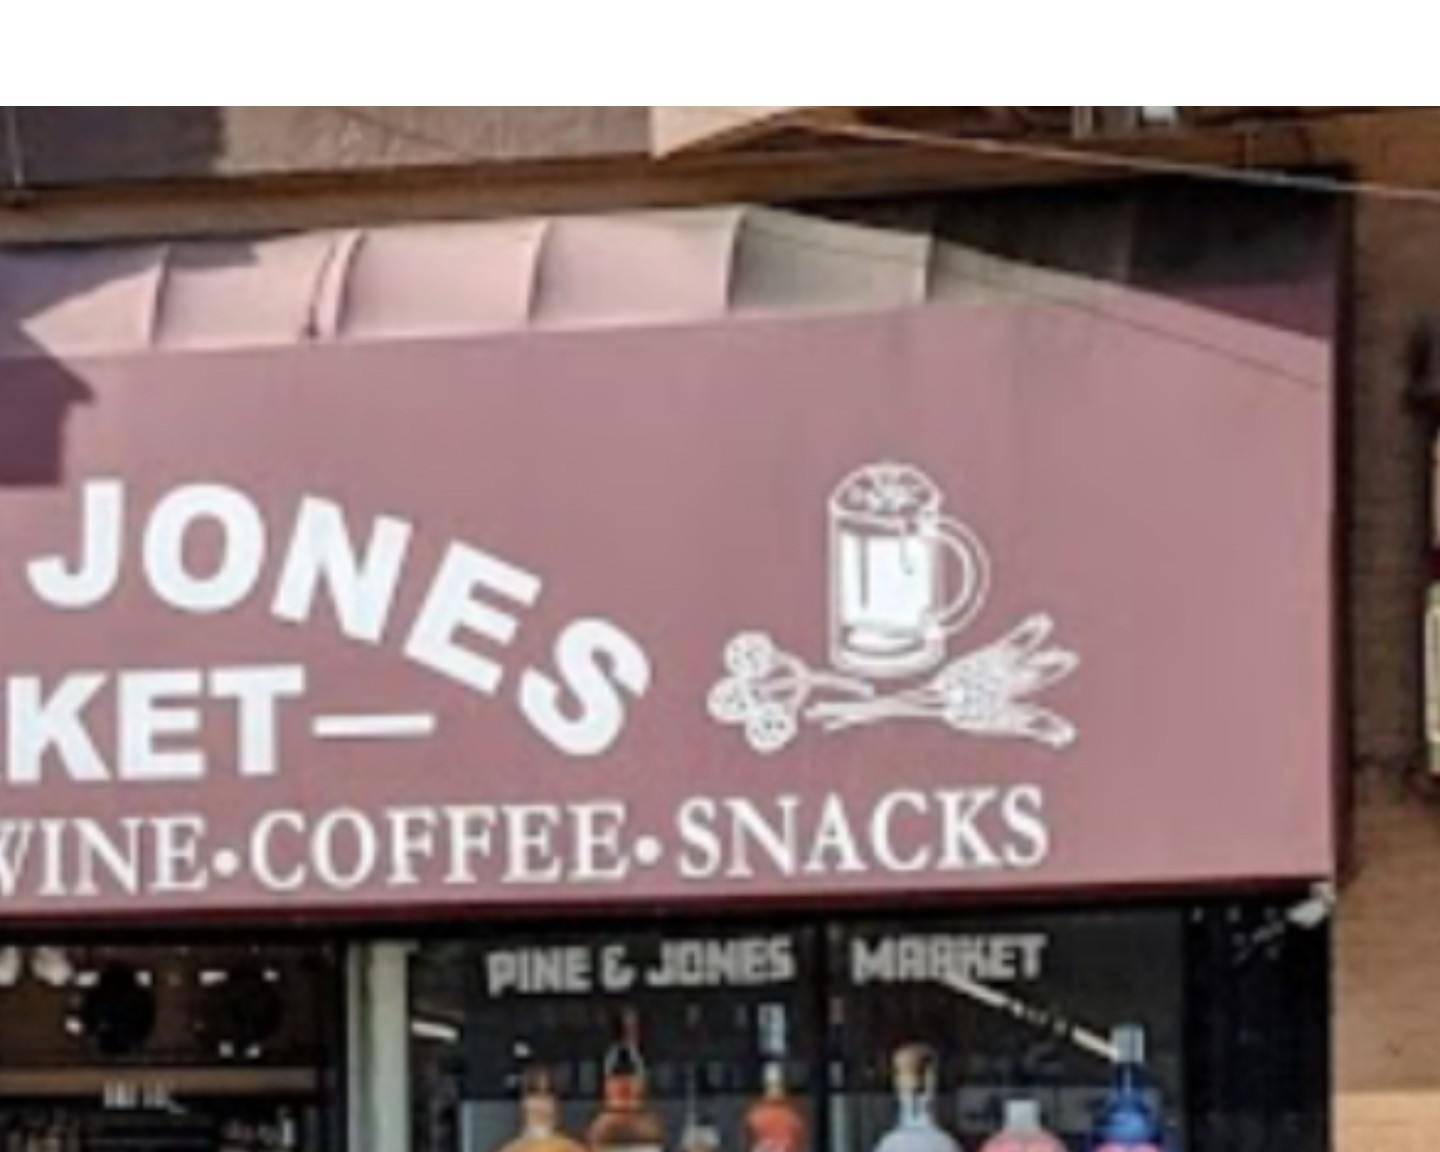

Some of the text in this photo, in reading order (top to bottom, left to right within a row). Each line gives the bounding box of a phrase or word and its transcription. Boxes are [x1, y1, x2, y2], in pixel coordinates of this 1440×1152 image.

[25, 476, 651, 757] JONES
[249, 801, 630, 891] COFFEE
[676, 784, 1049, 878] SNACKS
[485, 946, 593, 997] PINE
[646, 935, 797, 987] JONES
[850, 932, 1048, 985] MARKET
